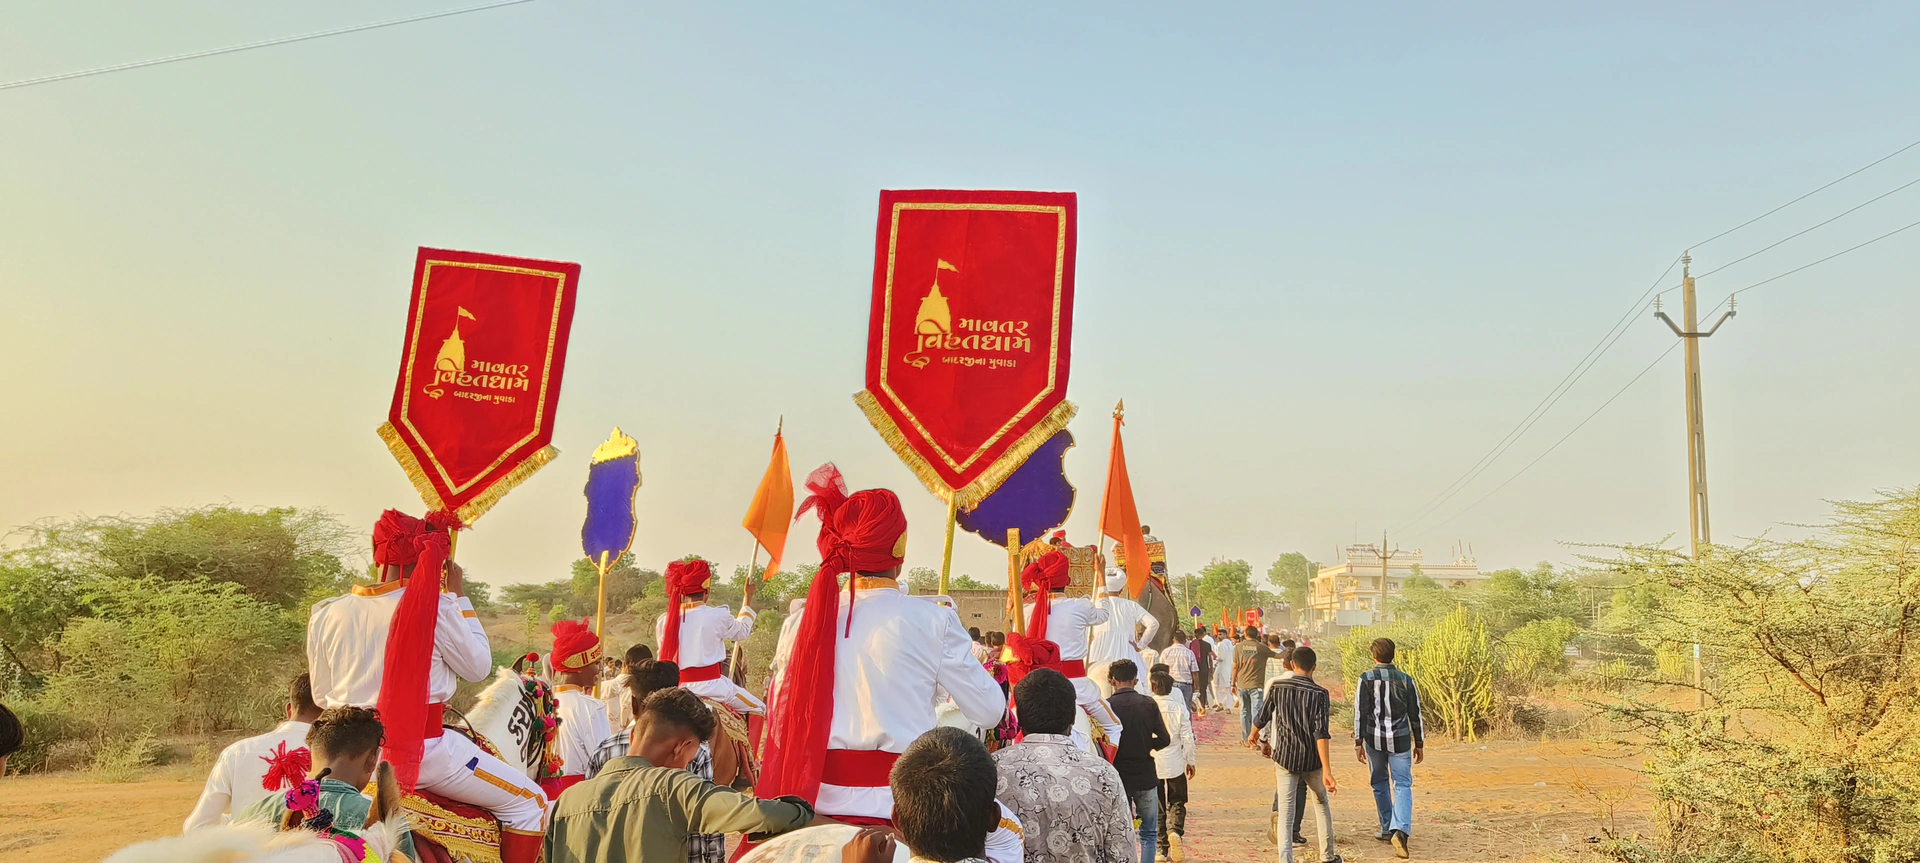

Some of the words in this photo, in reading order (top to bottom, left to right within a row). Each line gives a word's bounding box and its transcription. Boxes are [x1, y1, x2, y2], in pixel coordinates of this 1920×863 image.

[958, 318, 1029, 337] માવતર
[910, 321, 1031, 354] વિહતધામ
[471, 360, 529, 377] માવતર
[941, 356, 986, 367] બાદરજીના
[988, 358, 1017, 370] મુવાડા
[430, 360, 530, 392] વિહતધામ
[453, 390, 492, 402] બાદરજીના
[493, 394, 516, 405] મુવાડા
